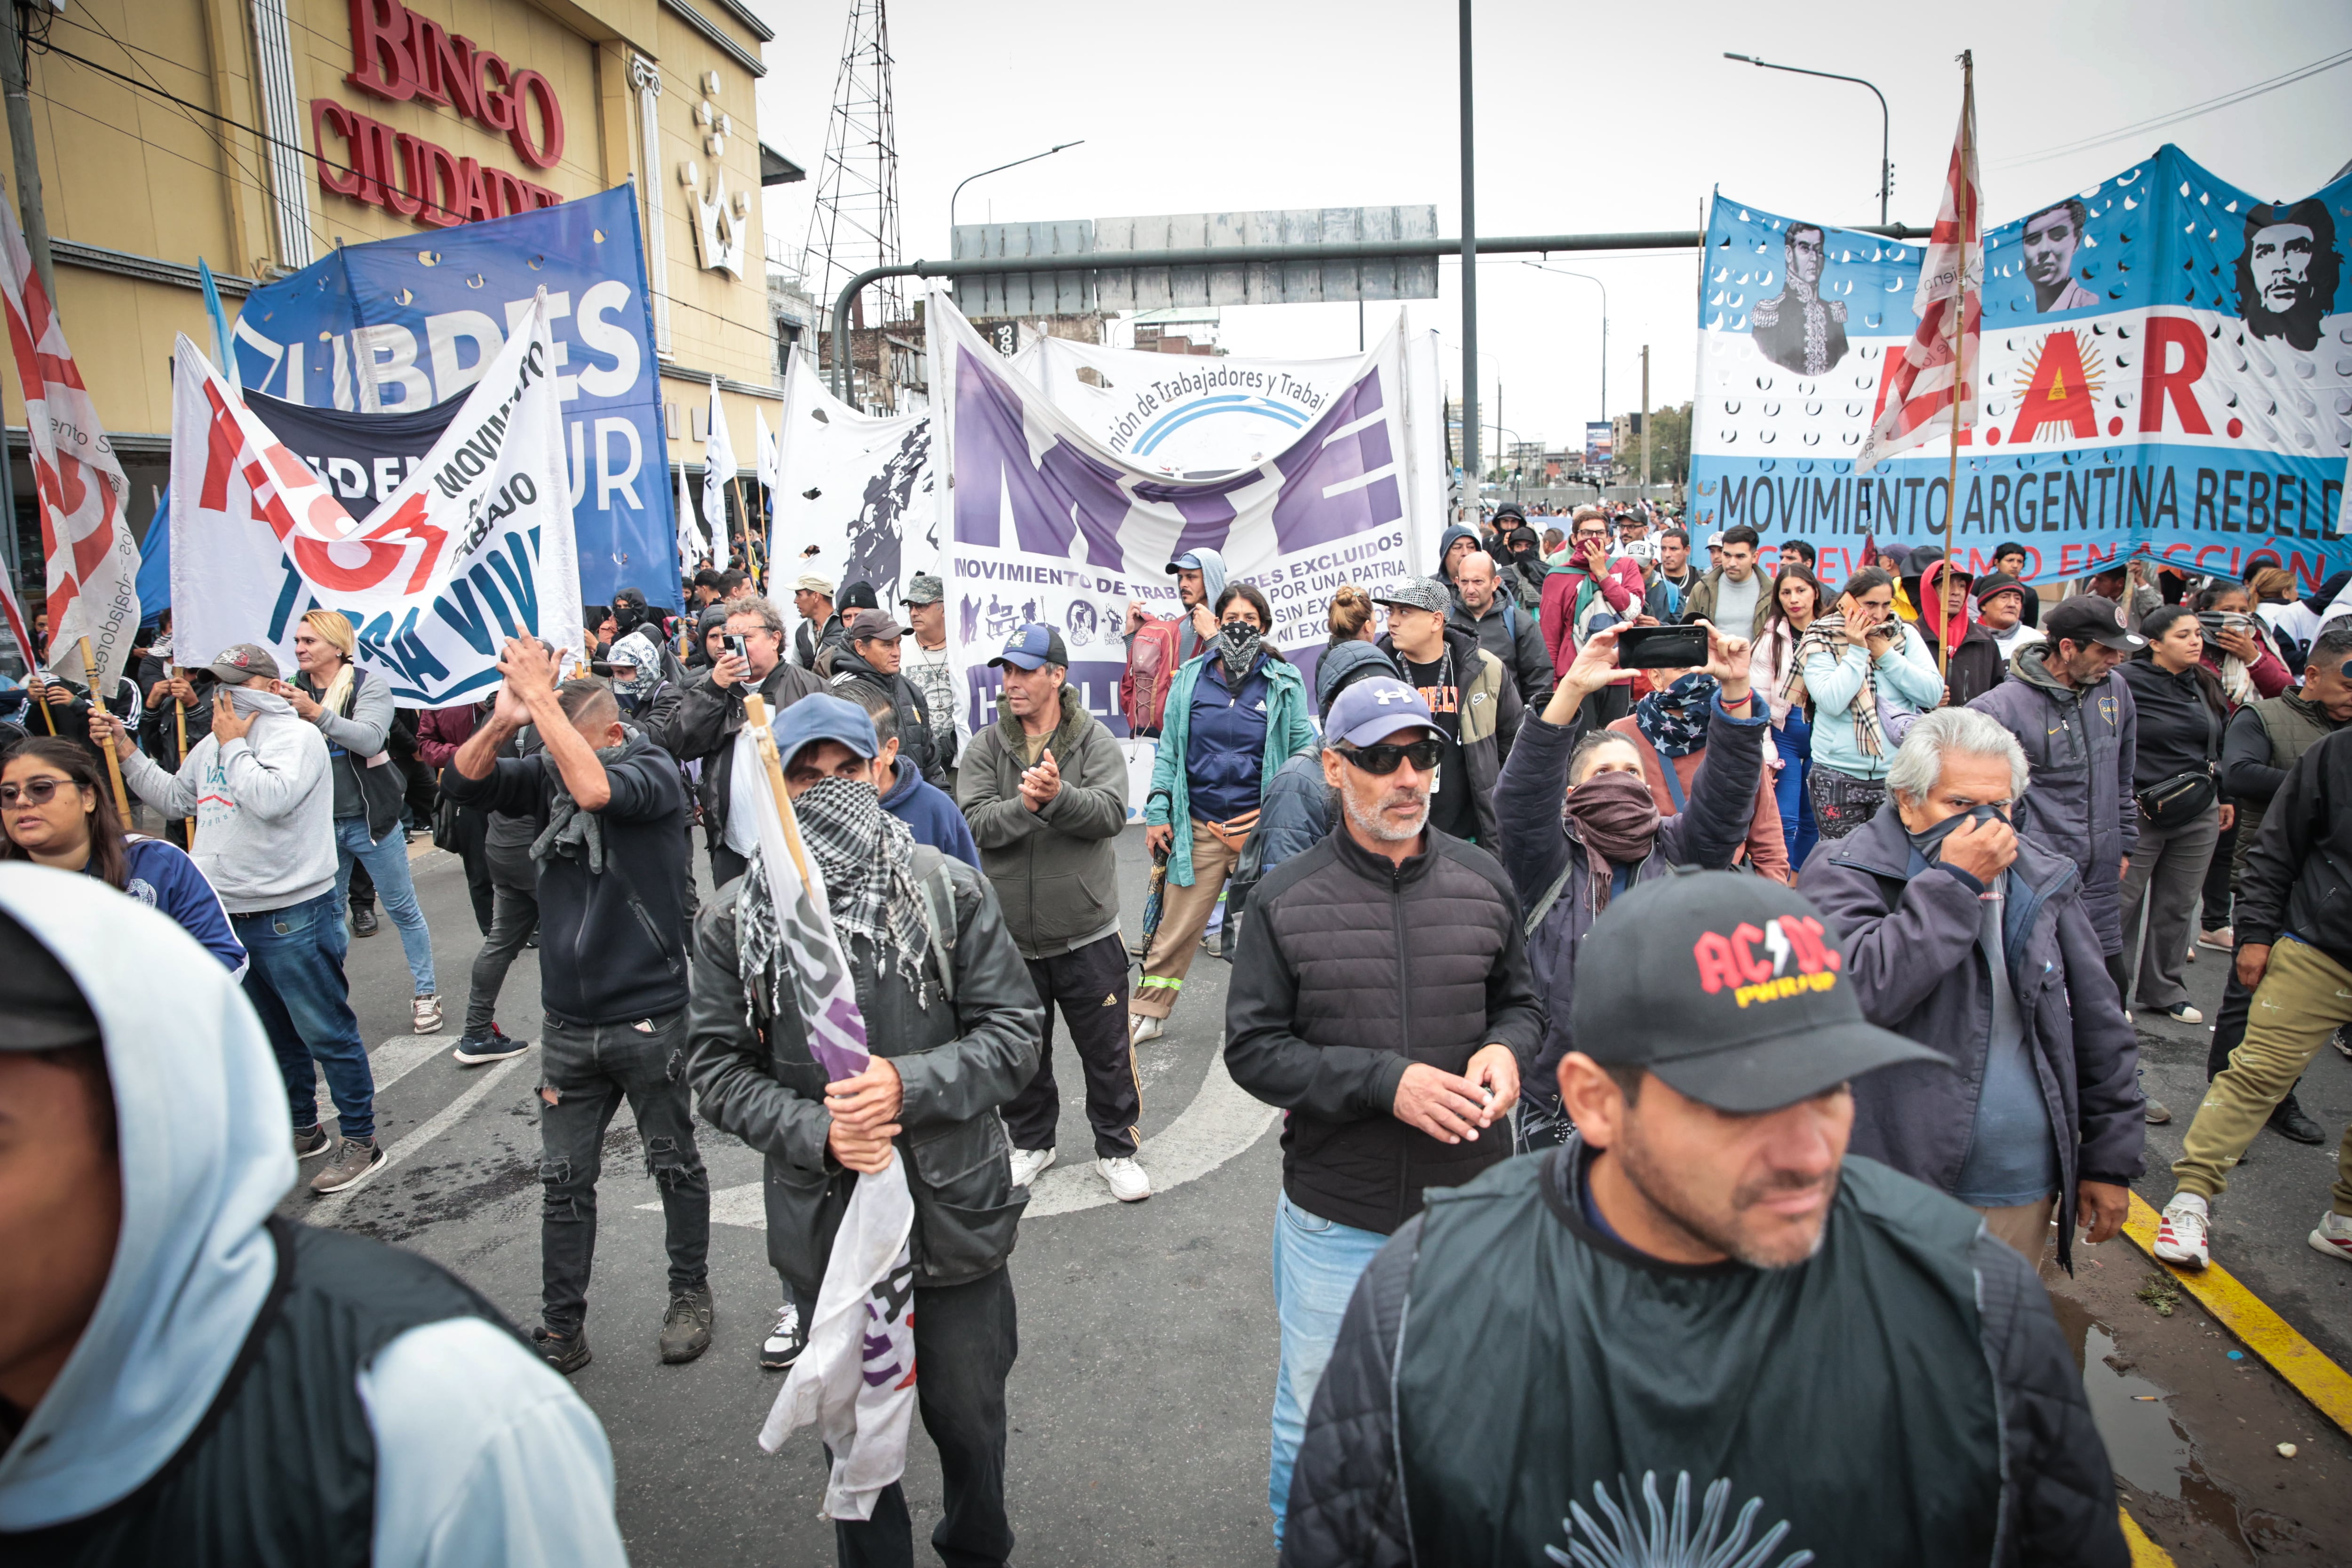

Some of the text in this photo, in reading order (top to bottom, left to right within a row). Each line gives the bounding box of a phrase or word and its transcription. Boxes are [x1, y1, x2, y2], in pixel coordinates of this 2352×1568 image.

[345, 0, 564, 169] BINGO
[1108, 365, 1329, 454] nión de Trabajadores y Trabaj
[1719, 465, 2345, 541] MOVIMIENTO ARGENTINA REBELD
[954, 557, 1092, 589] MOVIMIENTO
[1097, 578, 1127, 596] DE
[1290, 532, 1403, 578] EXCLUIDOS
[1270, 559, 1407, 604] POR UNA PATRIA
[1275, 604, 1302, 623] SIN
[1278, 627, 1293, 643] NI
